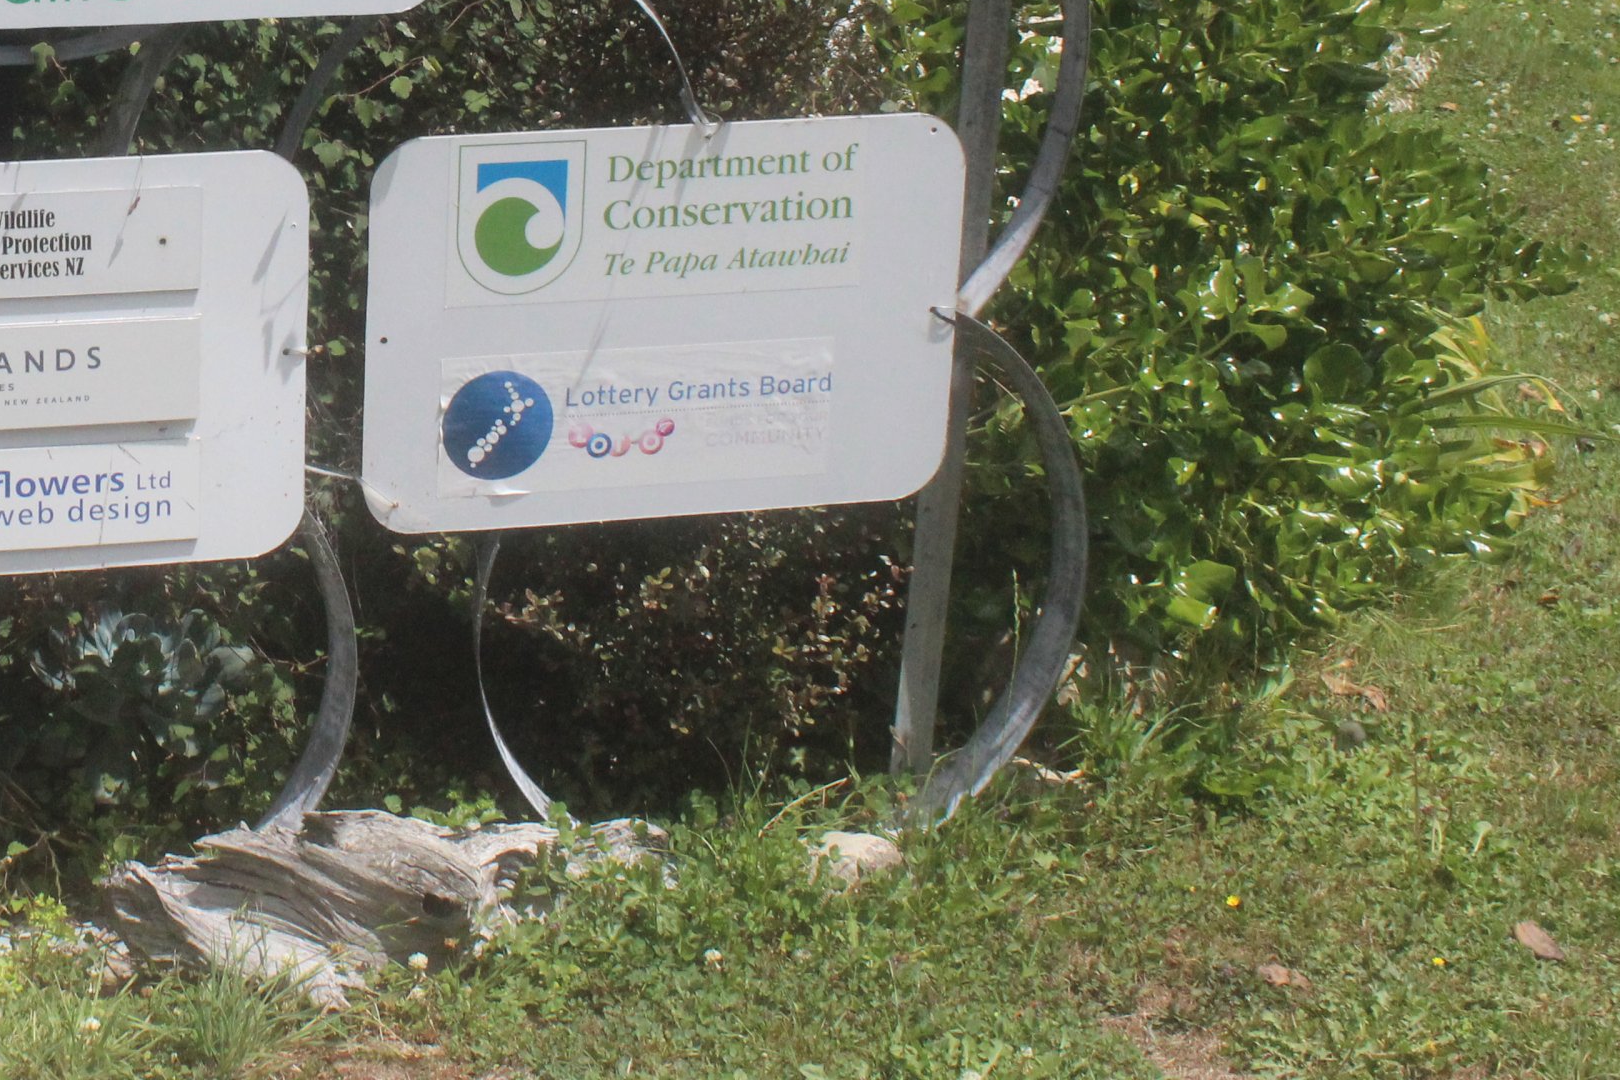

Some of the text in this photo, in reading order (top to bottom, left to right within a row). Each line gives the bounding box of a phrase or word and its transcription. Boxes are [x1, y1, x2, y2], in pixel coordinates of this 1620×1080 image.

[607, 142, 860, 189] Department of
[602, 190, 853, 231] Conservation
[1, 232, 92, 255] Protection
[64, 257, 85, 277] NZ
[603, 241, 852, 280] Te Papa Atawhai
[3, 398, 30, 407] NEW
[35, 394, 92, 405] ZEALAND
[565, 371, 833, 407] Lottery Grants Board
[136, 470, 172, 491] Ltd
[67, 496, 172, 525] design
